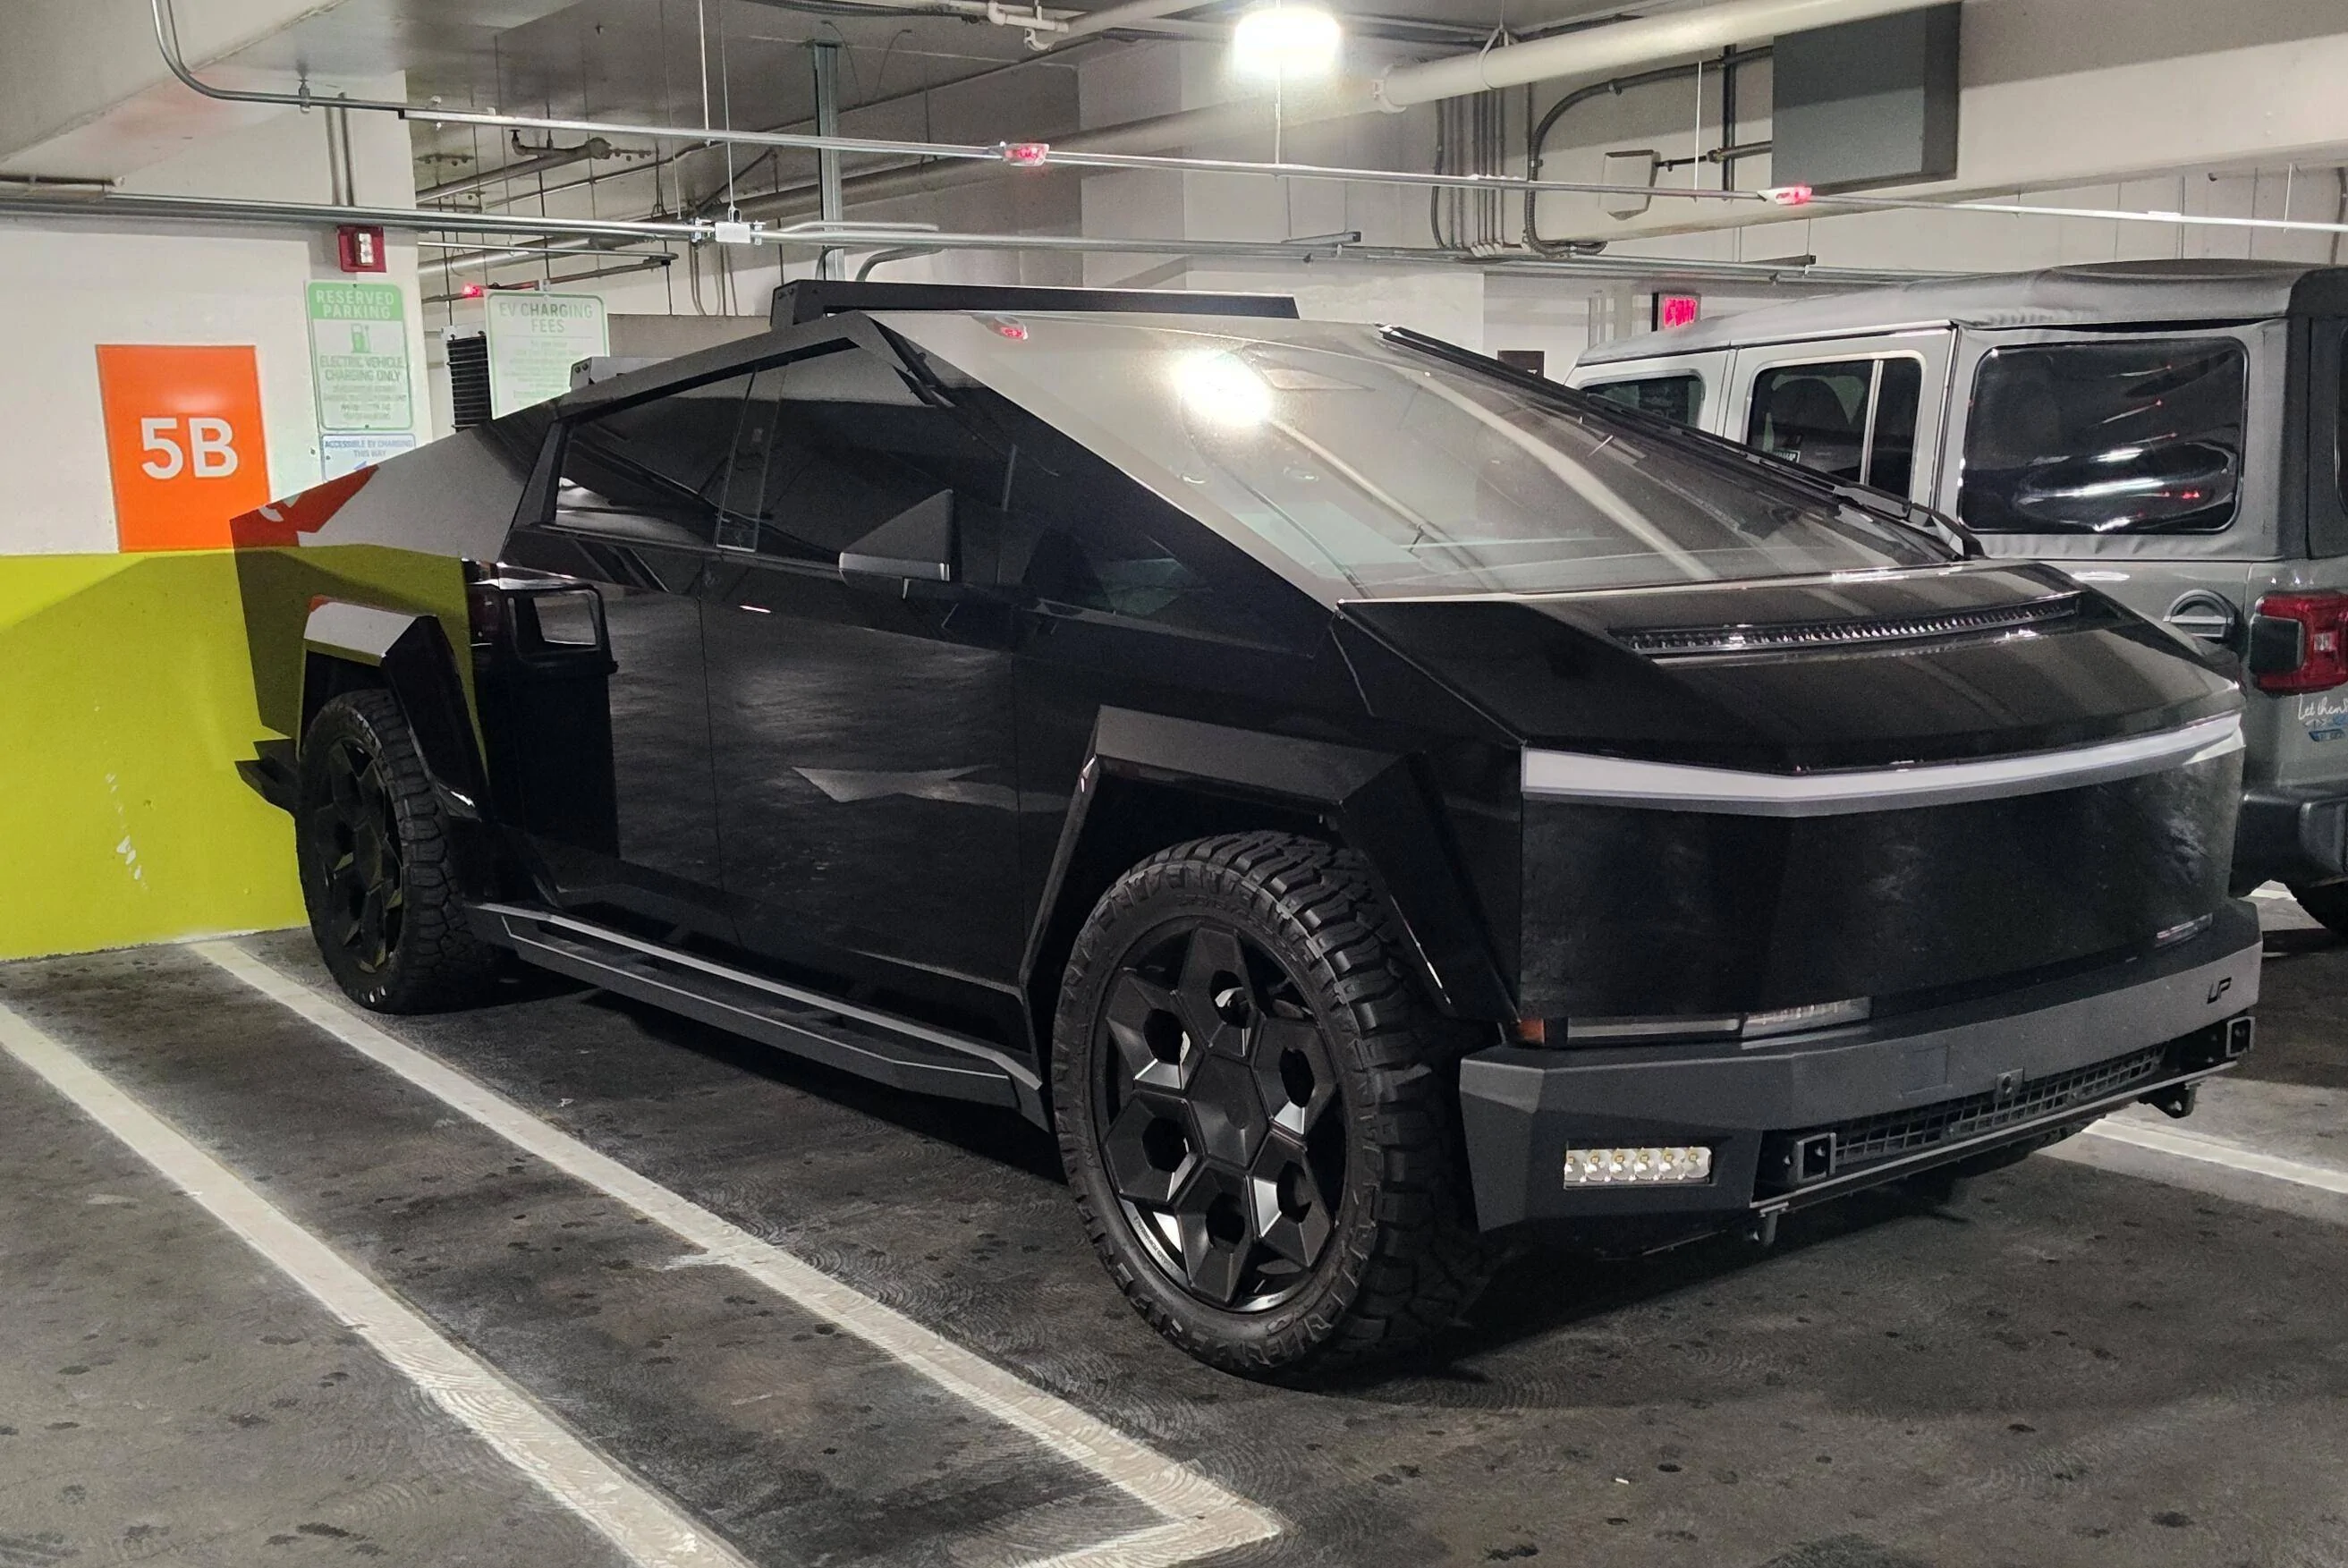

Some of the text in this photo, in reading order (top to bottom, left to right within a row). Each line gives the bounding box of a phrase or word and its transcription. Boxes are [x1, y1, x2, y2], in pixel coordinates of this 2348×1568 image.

[316, 289, 394, 305] RESERVED
[323, 304, 391, 319] PARKING
[499, 302, 592, 318] EV CHARGING
[531, 318, 565, 334] FEES
[319, 354, 405, 369] ELECTRIC VEHICLE
[325, 368, 401, 382] CHARGING ONLY
[140, 417, 238, 479] 5B
